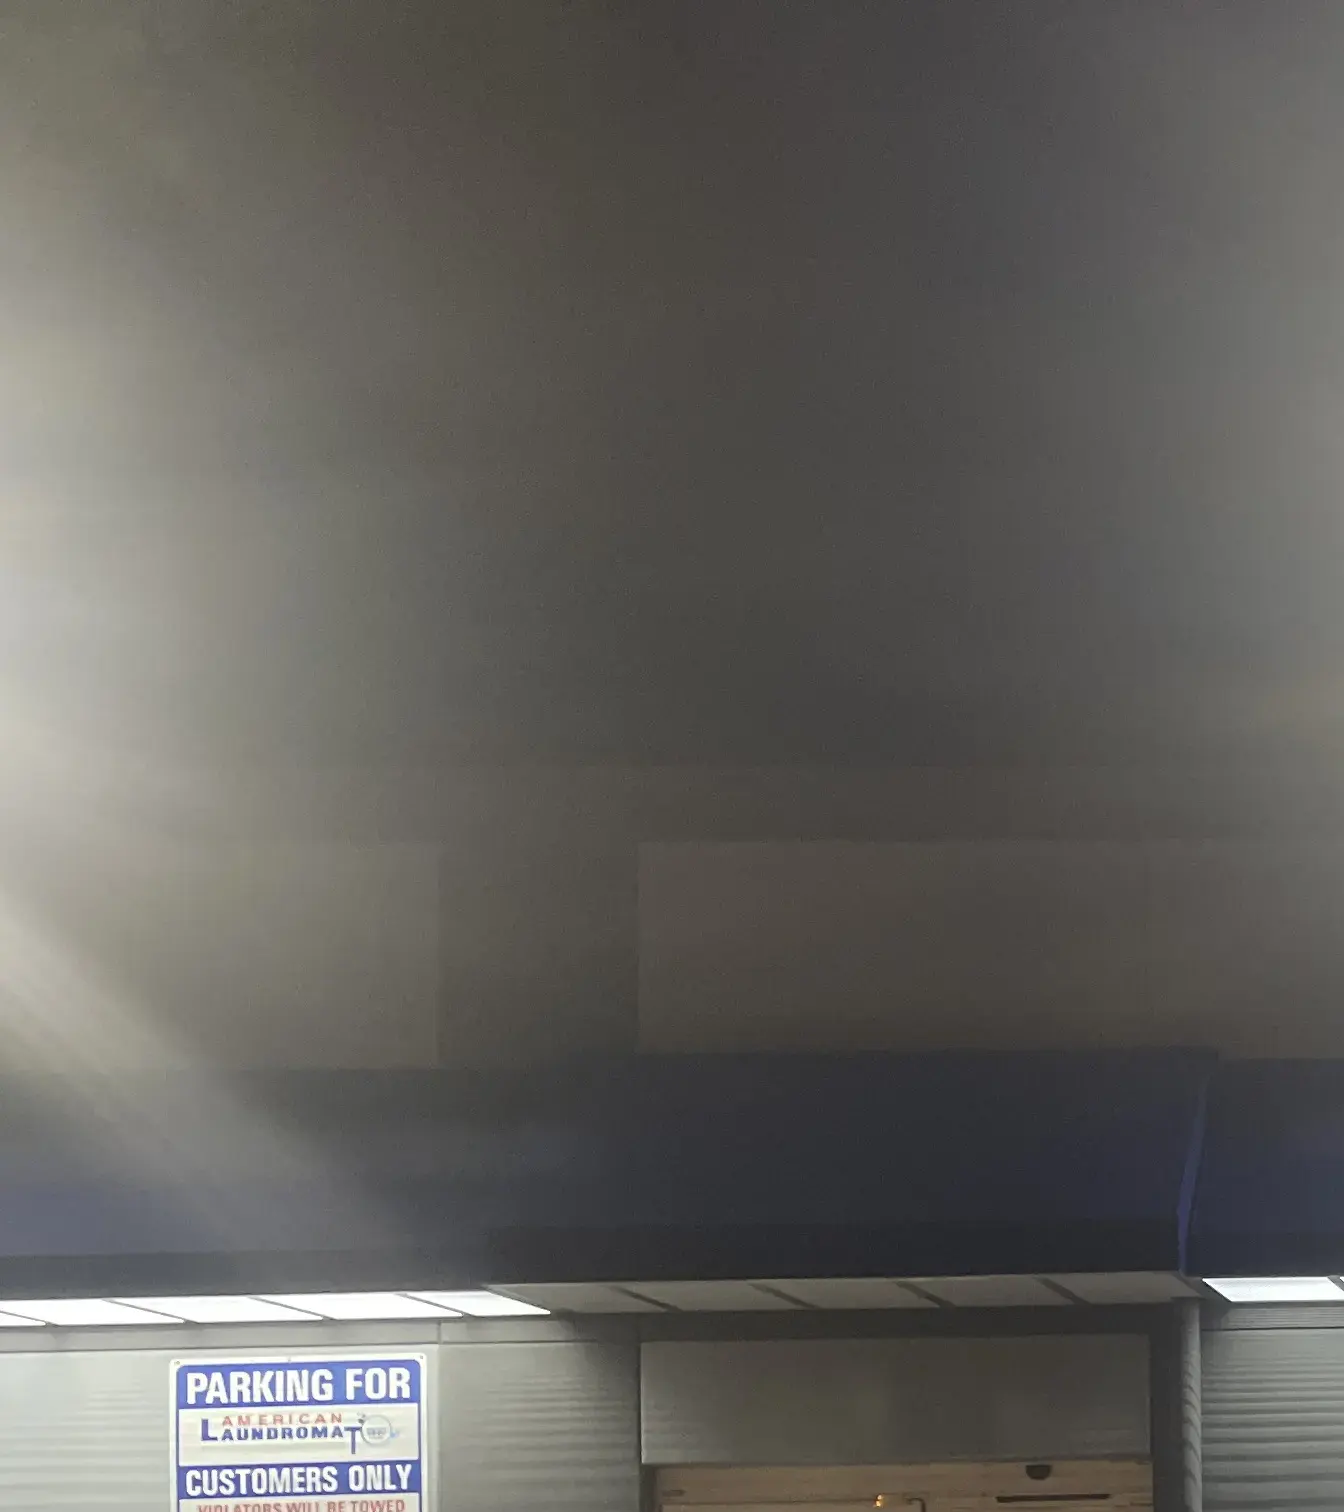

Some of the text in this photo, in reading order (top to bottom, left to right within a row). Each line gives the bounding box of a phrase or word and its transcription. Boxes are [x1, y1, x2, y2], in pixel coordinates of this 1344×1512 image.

[185, 1367, 411, 1405] PARKING FOR
[201, 1418, 362, 1455] LAUNDROMAT
[222, 1413, 343, 1426] AMERICAN
[185, 1464, 412, 1496] CUSTOMERS ONLY
